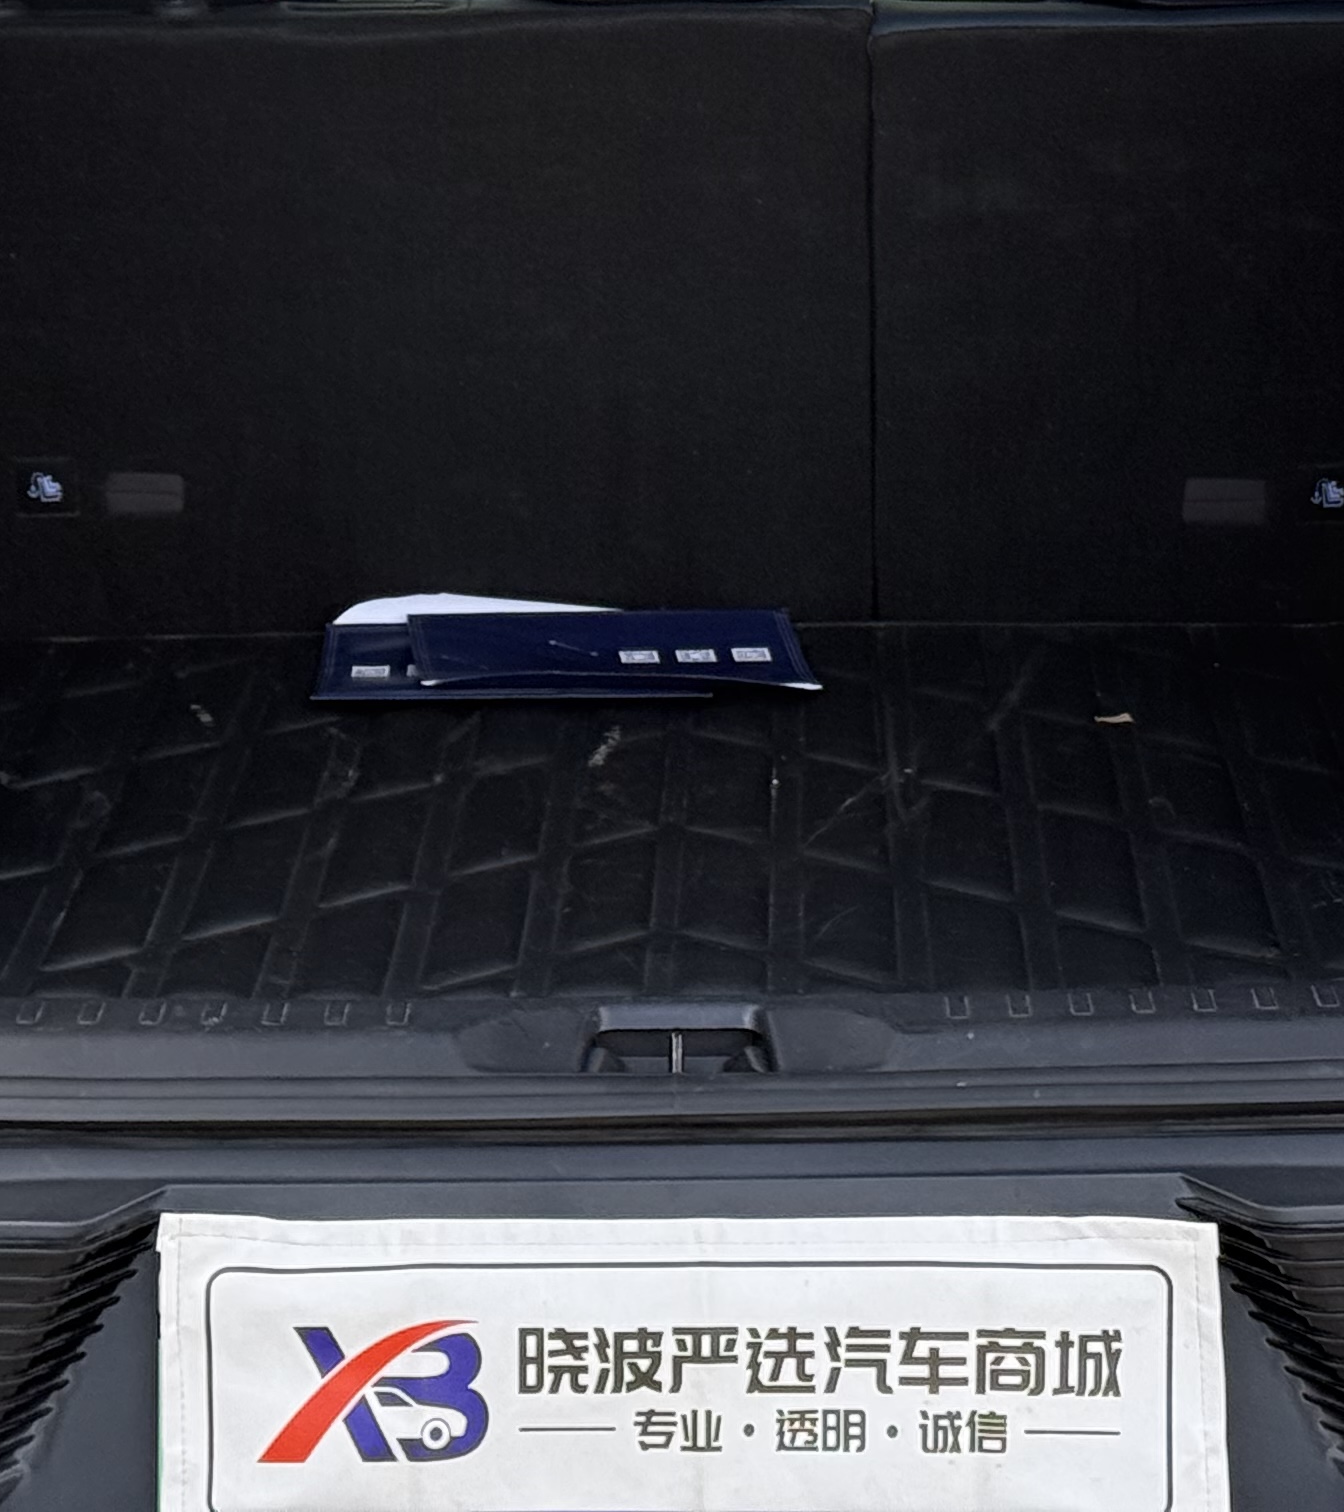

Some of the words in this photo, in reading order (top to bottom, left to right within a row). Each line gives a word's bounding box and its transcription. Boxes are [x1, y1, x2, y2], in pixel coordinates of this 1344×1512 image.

[518, 1326, 1122, 1396] 晓波严选汽车商城
